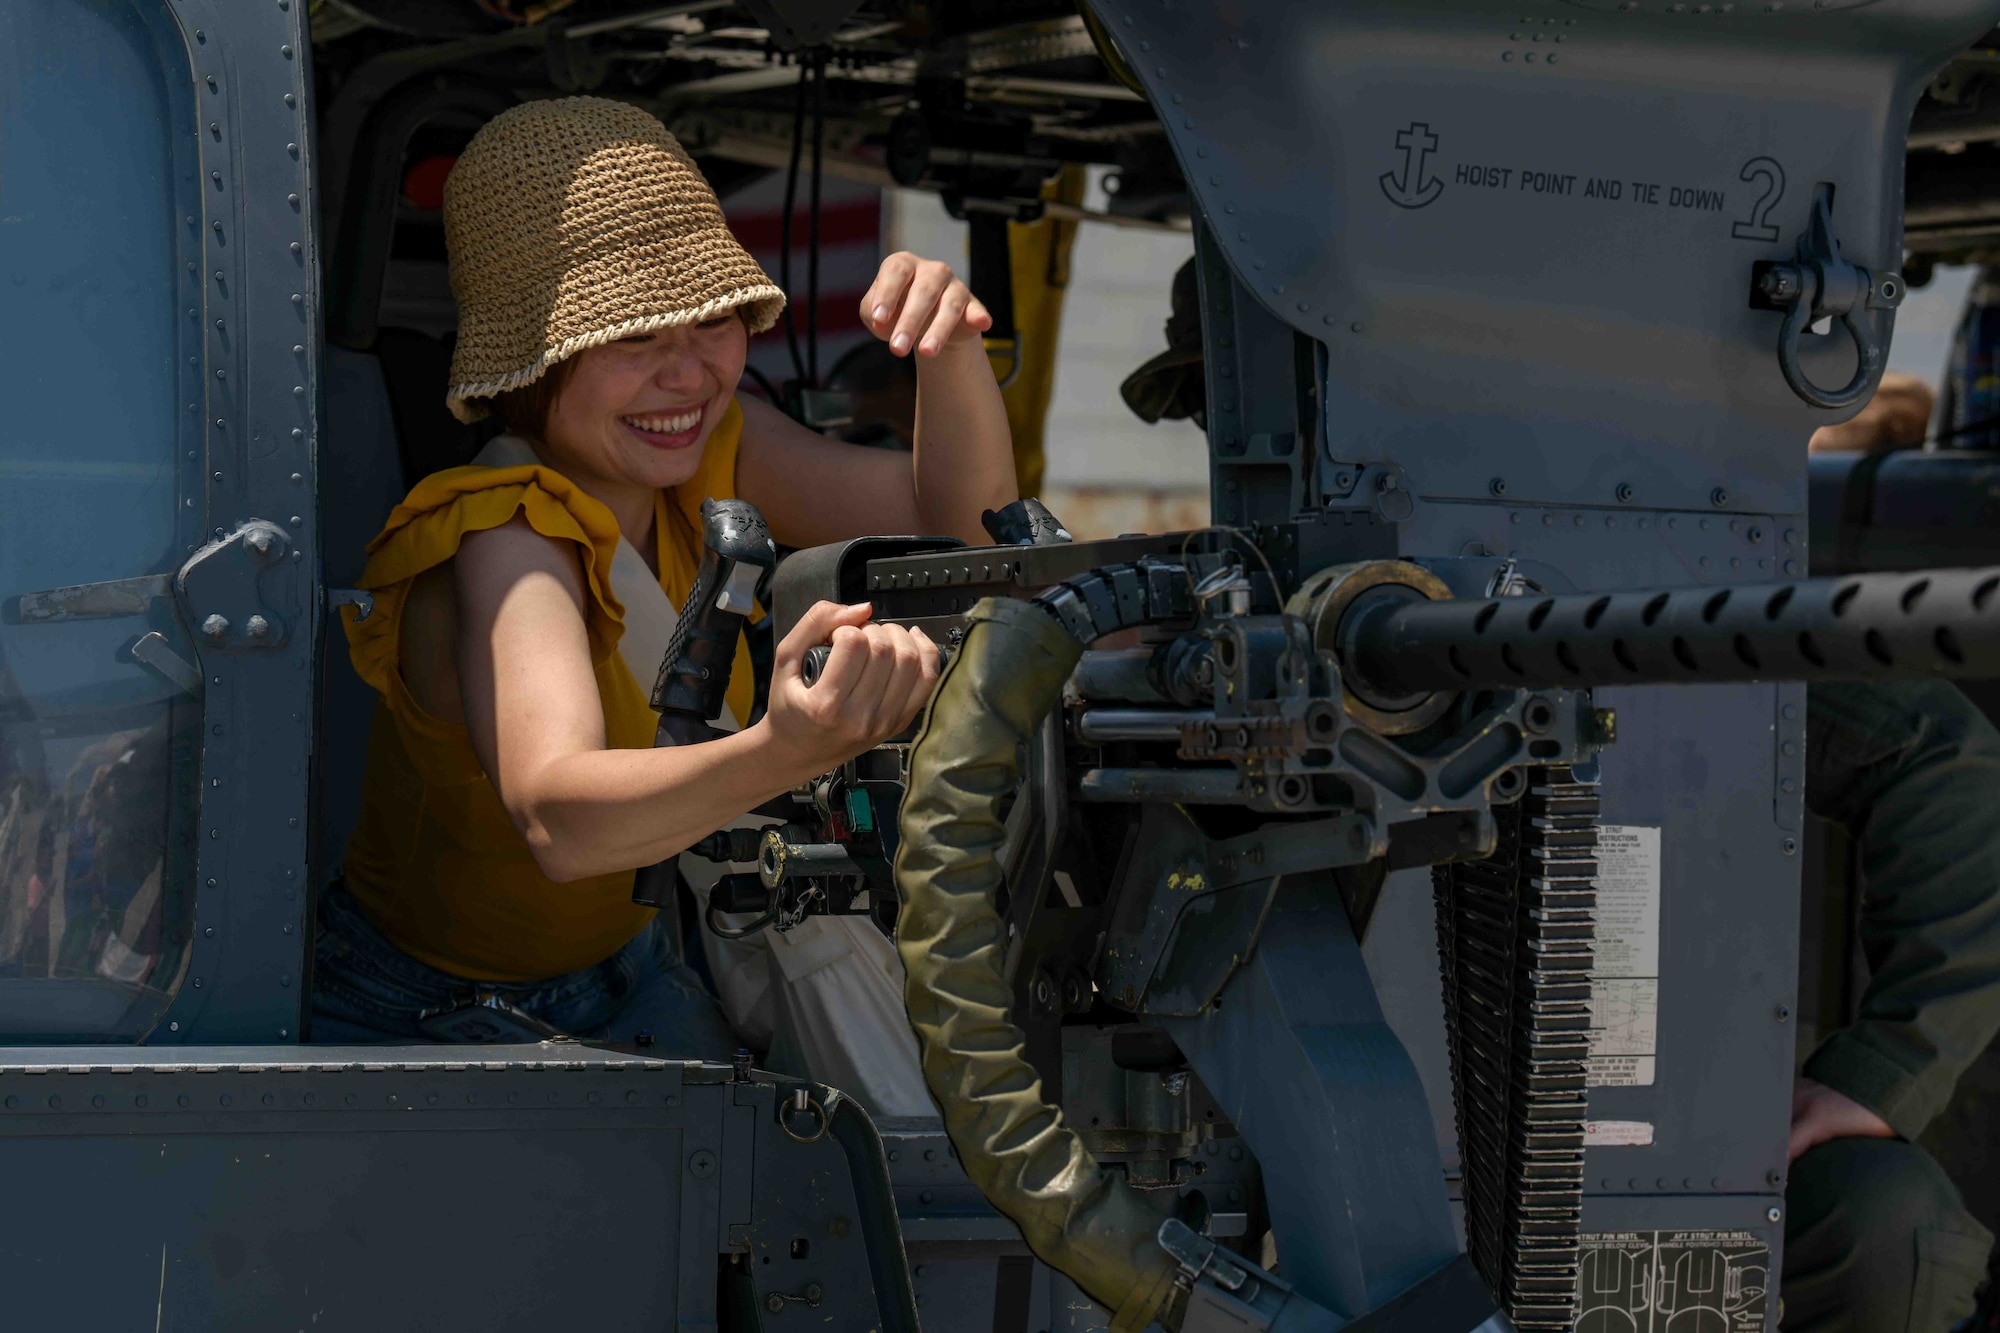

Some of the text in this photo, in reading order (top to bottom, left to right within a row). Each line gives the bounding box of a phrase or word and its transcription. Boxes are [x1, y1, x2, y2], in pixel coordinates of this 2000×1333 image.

[1455, 163, 1725, 212] HOIST POINT AND TIE DOWN
[1605, 826, 1623, 834] STRUT
[1599, 834, 1638, 842] INSTRUCTIONS
[1616, 1232, 1638, 1240] INSTL
[1673, 1232, 1688, 1240] AFT
[1730, 1231, 1752, 1239] INSTL
[1737, 1322, 1761, 1330] INSERT
